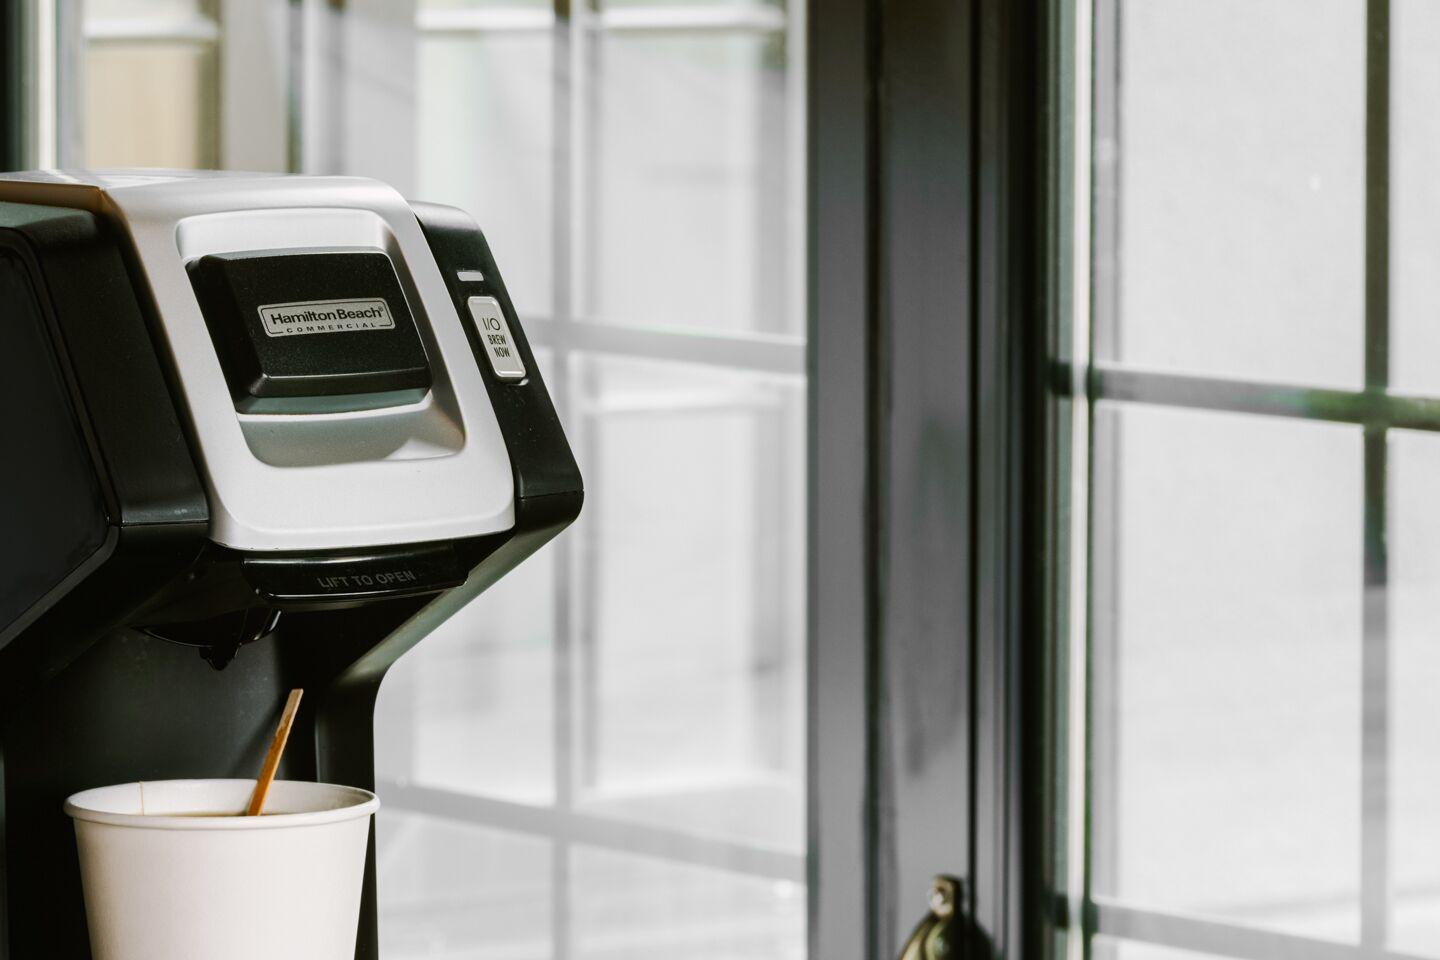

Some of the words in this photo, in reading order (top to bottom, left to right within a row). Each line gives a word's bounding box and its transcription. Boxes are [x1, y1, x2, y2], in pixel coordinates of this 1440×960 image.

[286, 322, 377, 334] COMMERCIAL
[487, 334, 507, 345] BREW
[493, 347, 511, 358] NOW
[317, 576, 349, 589] LIFT
[350, 574, 374, 587] TO
[375, 570, 417, 585] OPEN
